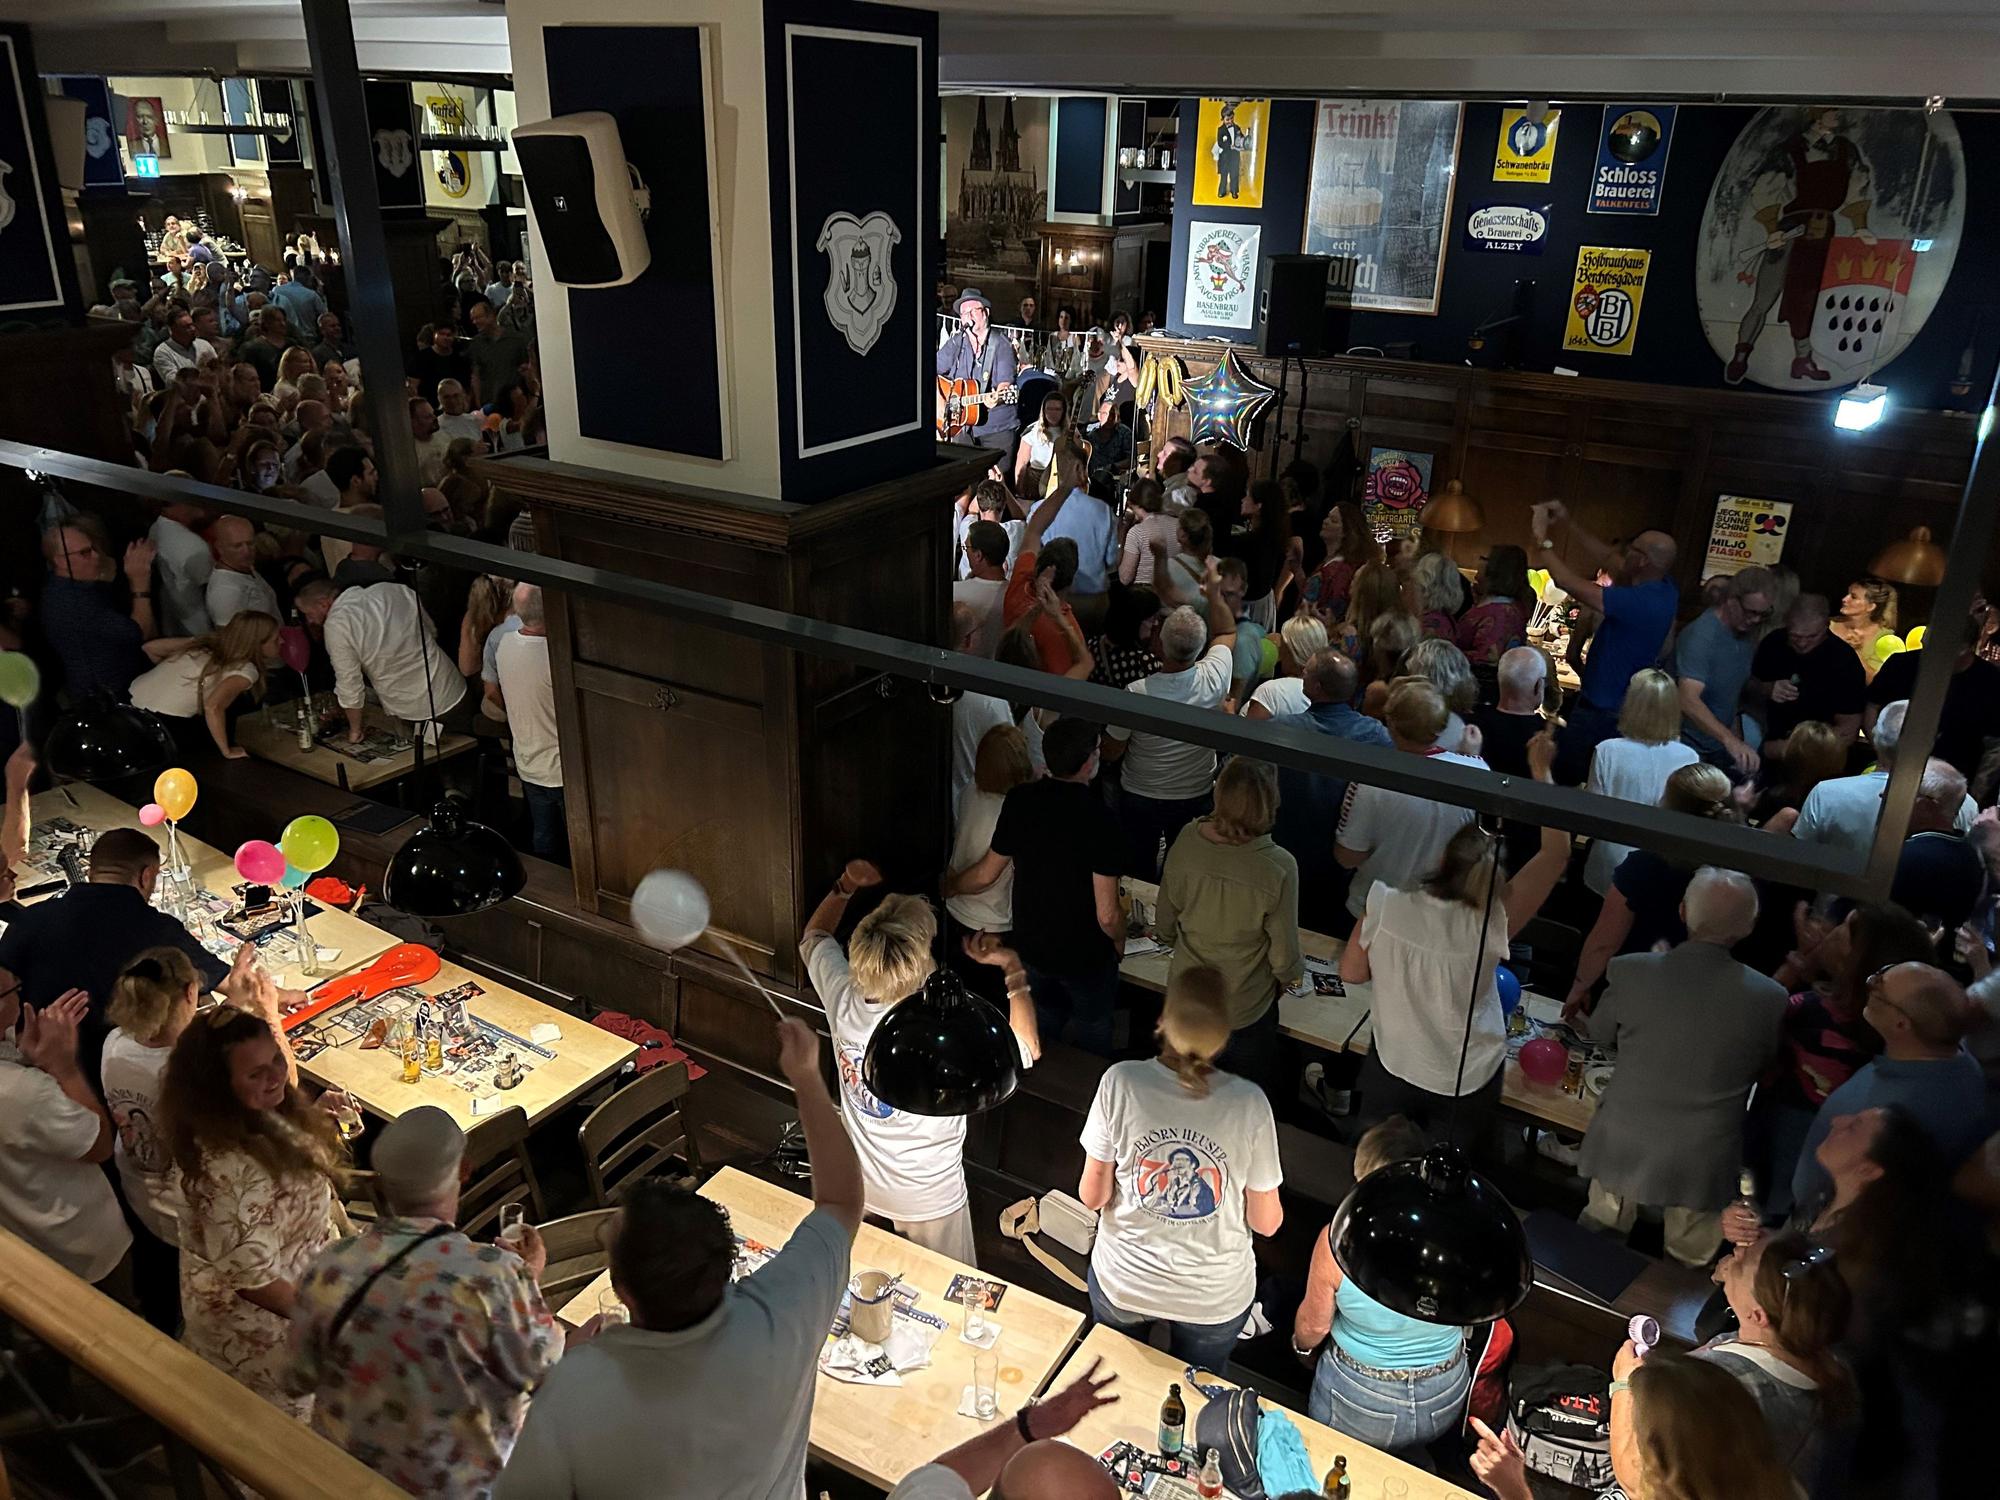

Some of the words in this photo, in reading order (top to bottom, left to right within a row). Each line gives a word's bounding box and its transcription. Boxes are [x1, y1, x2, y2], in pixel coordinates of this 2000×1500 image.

[1497, 159, 1550, 171] Schwanenbräu
[1598, 166, 1657, 185] Schloss
[1595, 183, 1656, 199] Brauerei
[1596, 199, 1649, 209] FALKENFELS
[1487, 227, 1522, 238] Brauerei
[1332, 240, 1357, 252] echt
[1485, 242, 1524, 251] ALZEY
[1577, 267, 1644, 287] Berchtesgaden
[1366, 514, 1417, 524] SOMMERGARTE
[1717, 509, 1740, 518] JECK
[1716, 515, 1751, 526] SUNNE
[1709, 546, 1752, 559] FIASKO
[1134, 1127, 1178, 1152] BJÖRN
